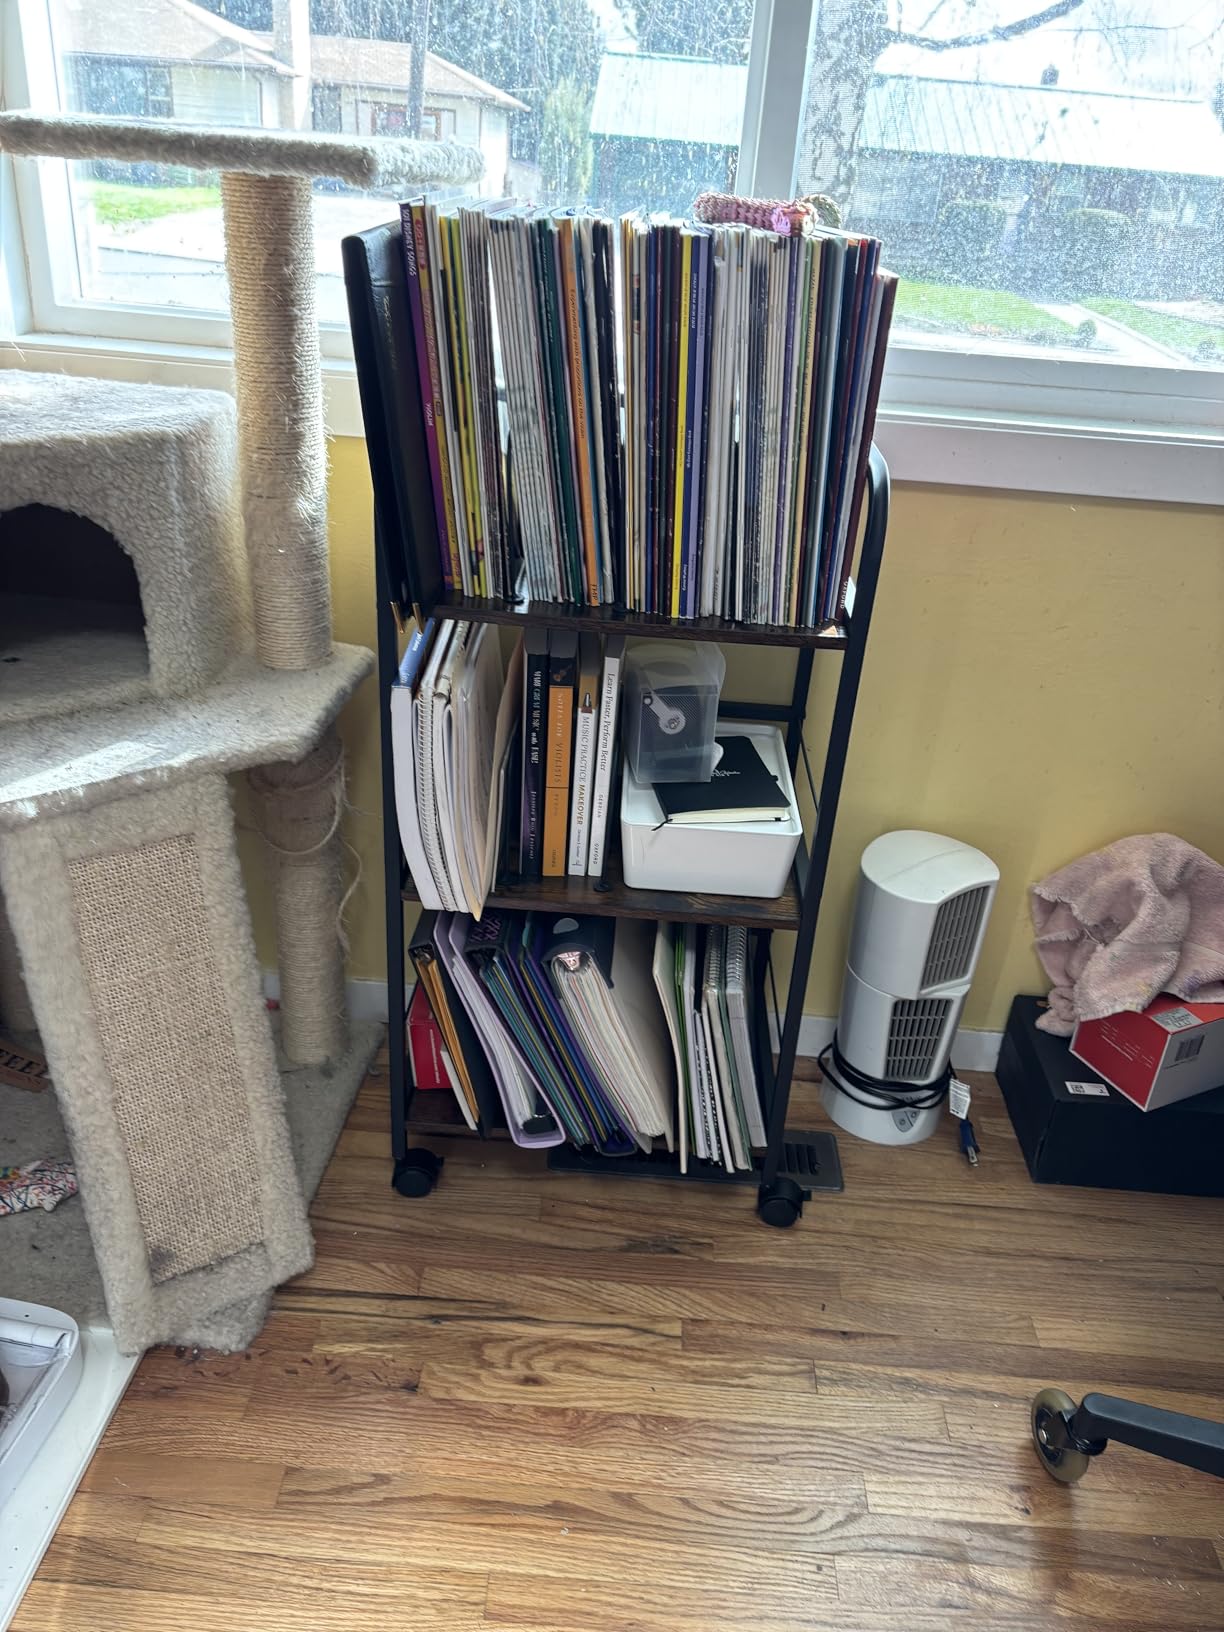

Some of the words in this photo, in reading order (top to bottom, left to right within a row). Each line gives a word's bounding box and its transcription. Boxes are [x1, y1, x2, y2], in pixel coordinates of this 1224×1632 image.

[402, 221, 414, 250] DISNEY
[405, 250, 418, 277] SONGS
[423, 401, 435, 426] VIOLIN
[605, 672, 615, 694] Learn
[602, 695, 613, 720] Faster,
[580, 715, 590, 743] MUSIC
[601, 720, 611, 749] Perform
[553, 742, 563, 783] VIOLISTS
[578, 743, 588, 782] PRACTICE
[599, 749, 609, 771] Better
[576, 784, 585, 825] MAKEOVER
[591, 842, 600, 865] OXFORD
